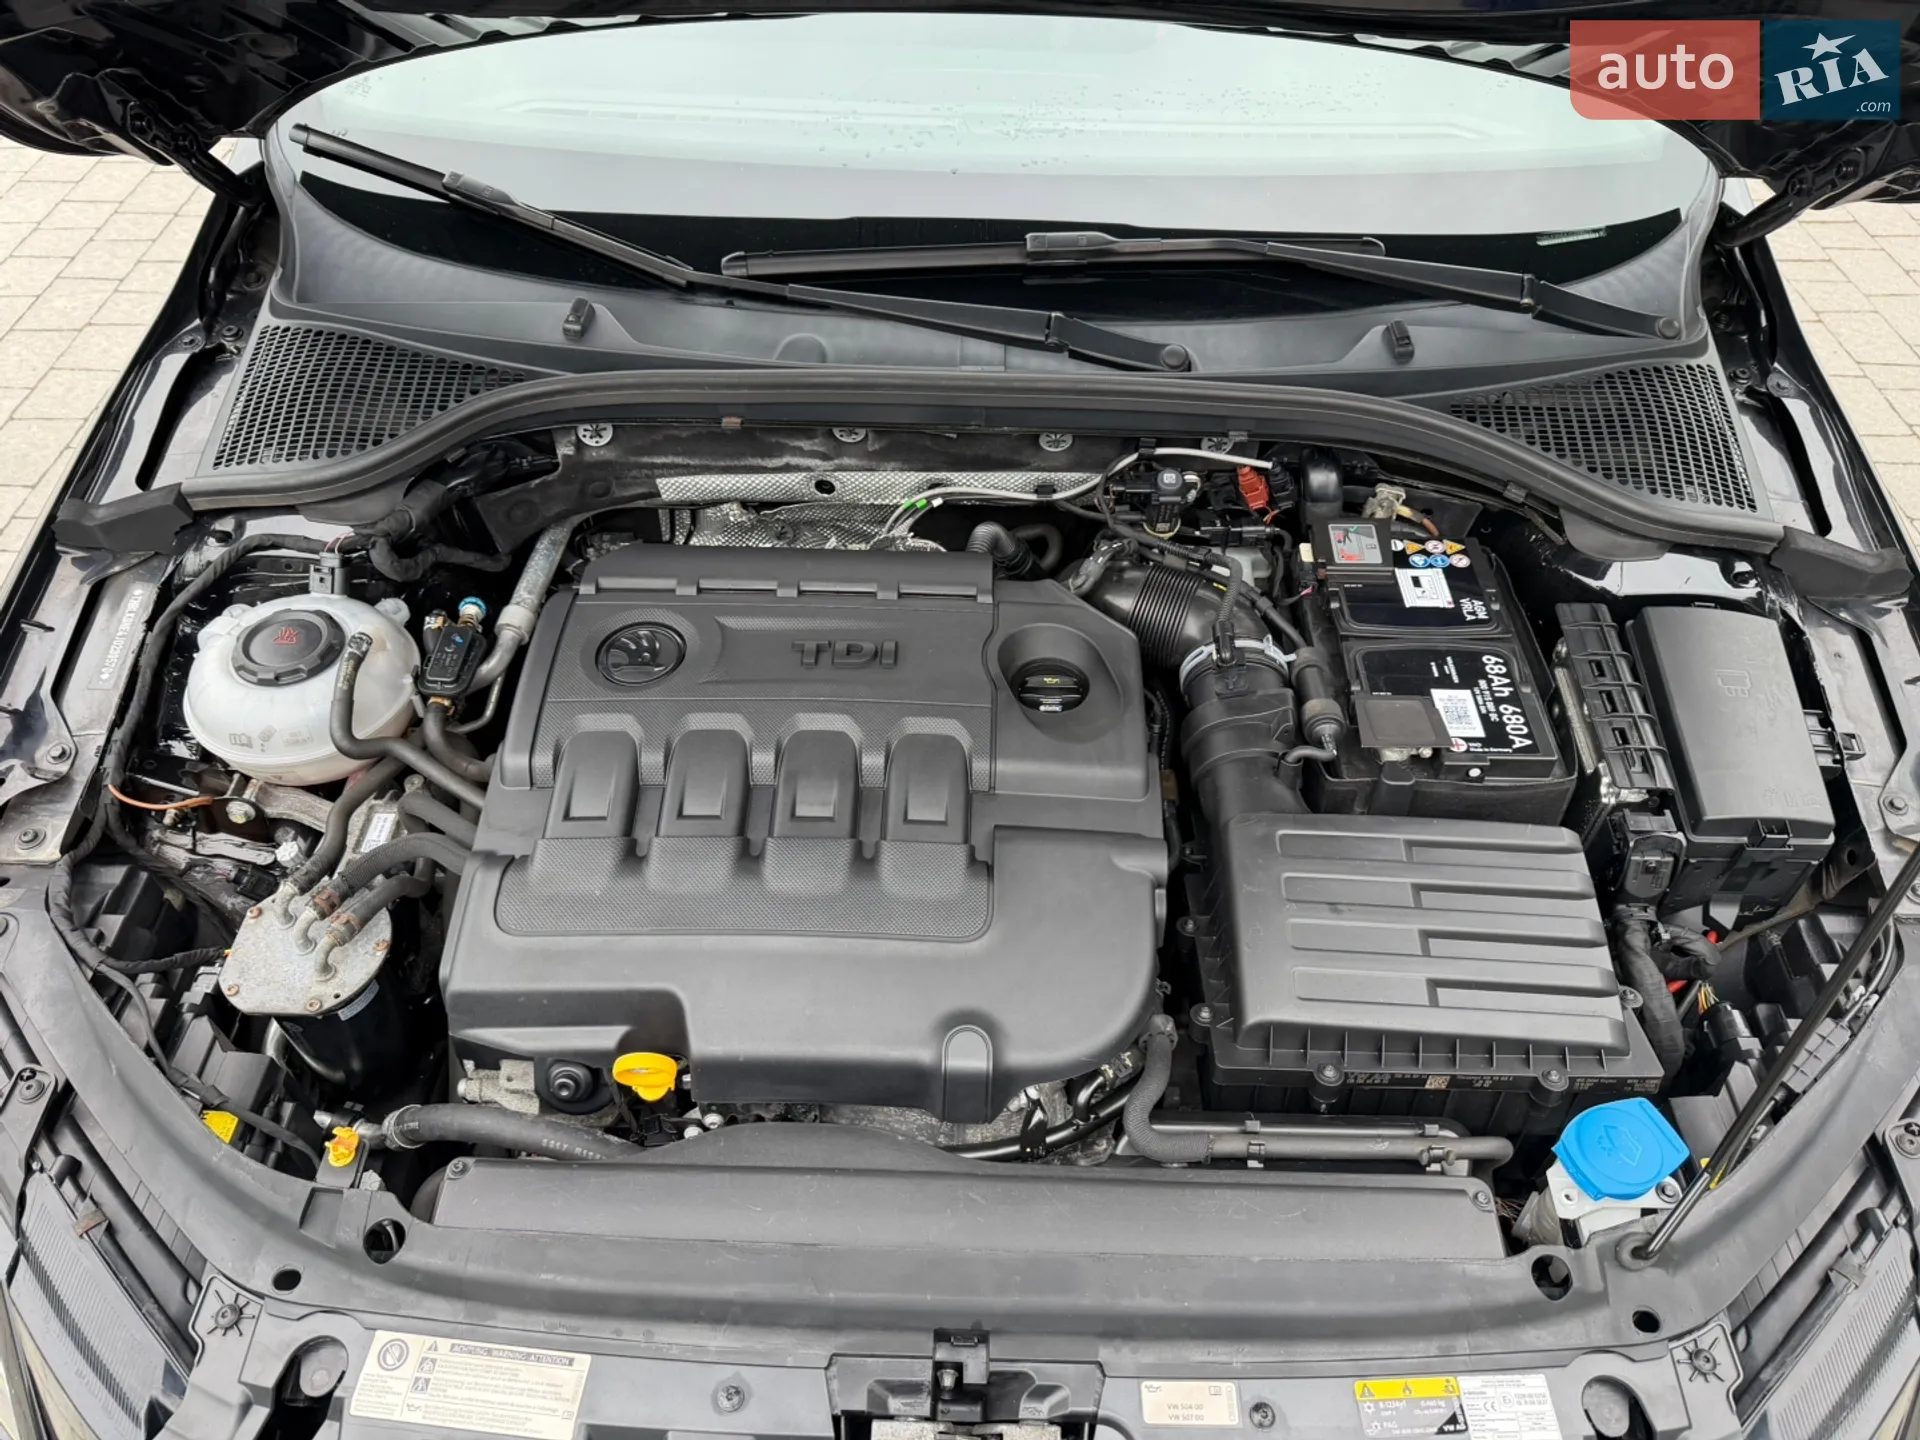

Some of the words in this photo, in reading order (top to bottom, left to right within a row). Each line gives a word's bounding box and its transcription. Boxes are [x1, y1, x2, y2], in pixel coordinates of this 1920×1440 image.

[1459, 597, 1476, 621] VRLA
[1471, 600, 1489, 619] AGM
[792, 640, 898, 668] TDI
[1482, 655, 1514, 697] 68Ah
[1499, 704, 1533, 749] 680A
[452, 1345, 488, 1356] ACHTUNG
[492, 1349, 527, 1360] WARNING
[529, 1353, 569, 1365] ATTENTION
